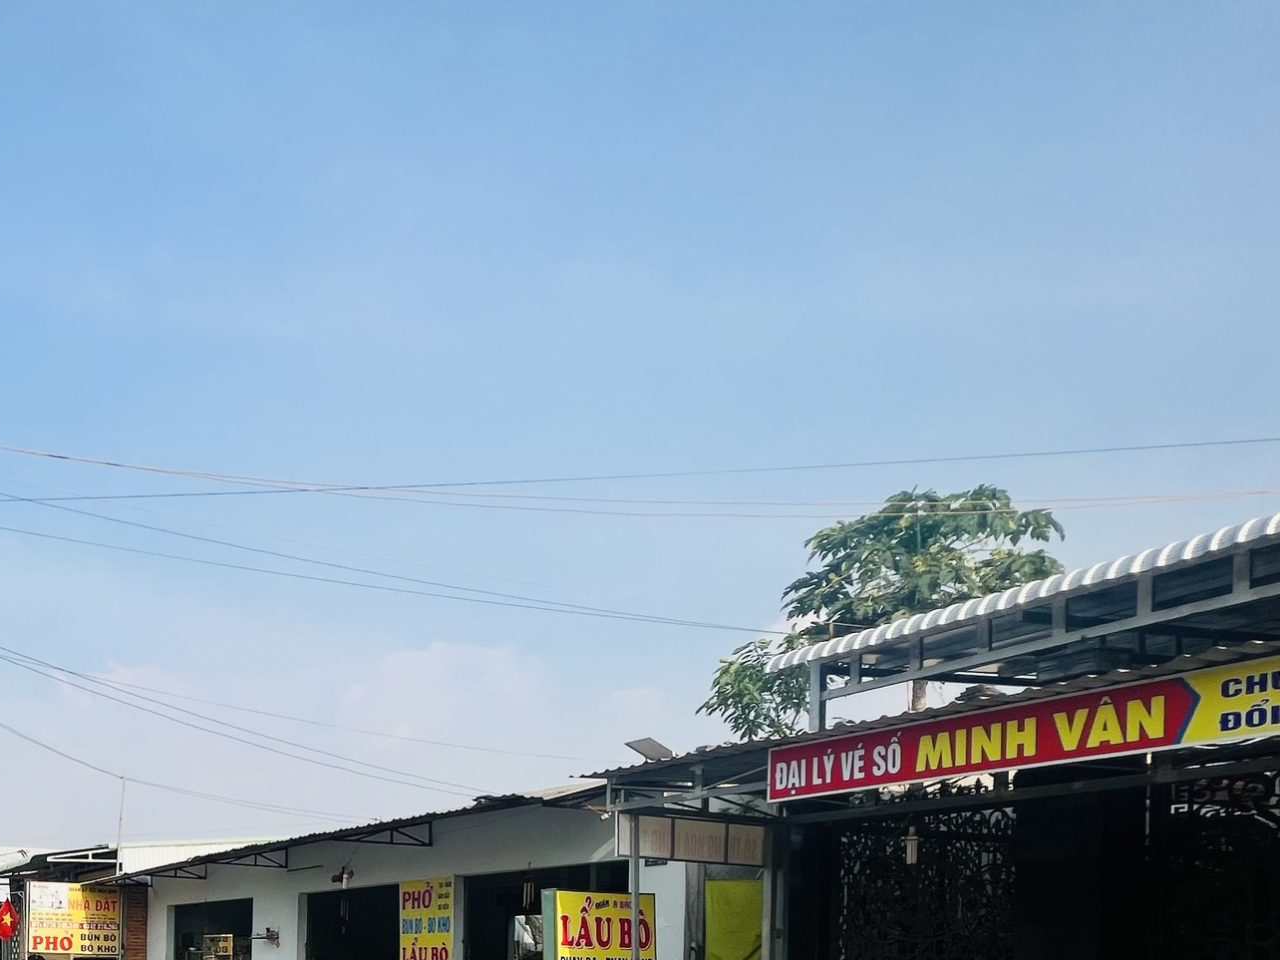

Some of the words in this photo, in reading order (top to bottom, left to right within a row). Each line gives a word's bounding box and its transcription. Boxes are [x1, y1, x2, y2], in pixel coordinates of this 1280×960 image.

[775, 758, 806, 795] ĐẠI
[812, 748, 834, 785] LÝ
[841, 742, 865, 781] VÉ
[872, 731, 901, 776] SỐ
[915, 716, 1037, 772] MINH
[1052, 695, 1165, 751] VÂN
[402, 881, 434, 910] PHỞ
[560, 896, 612, 950] LẨU
